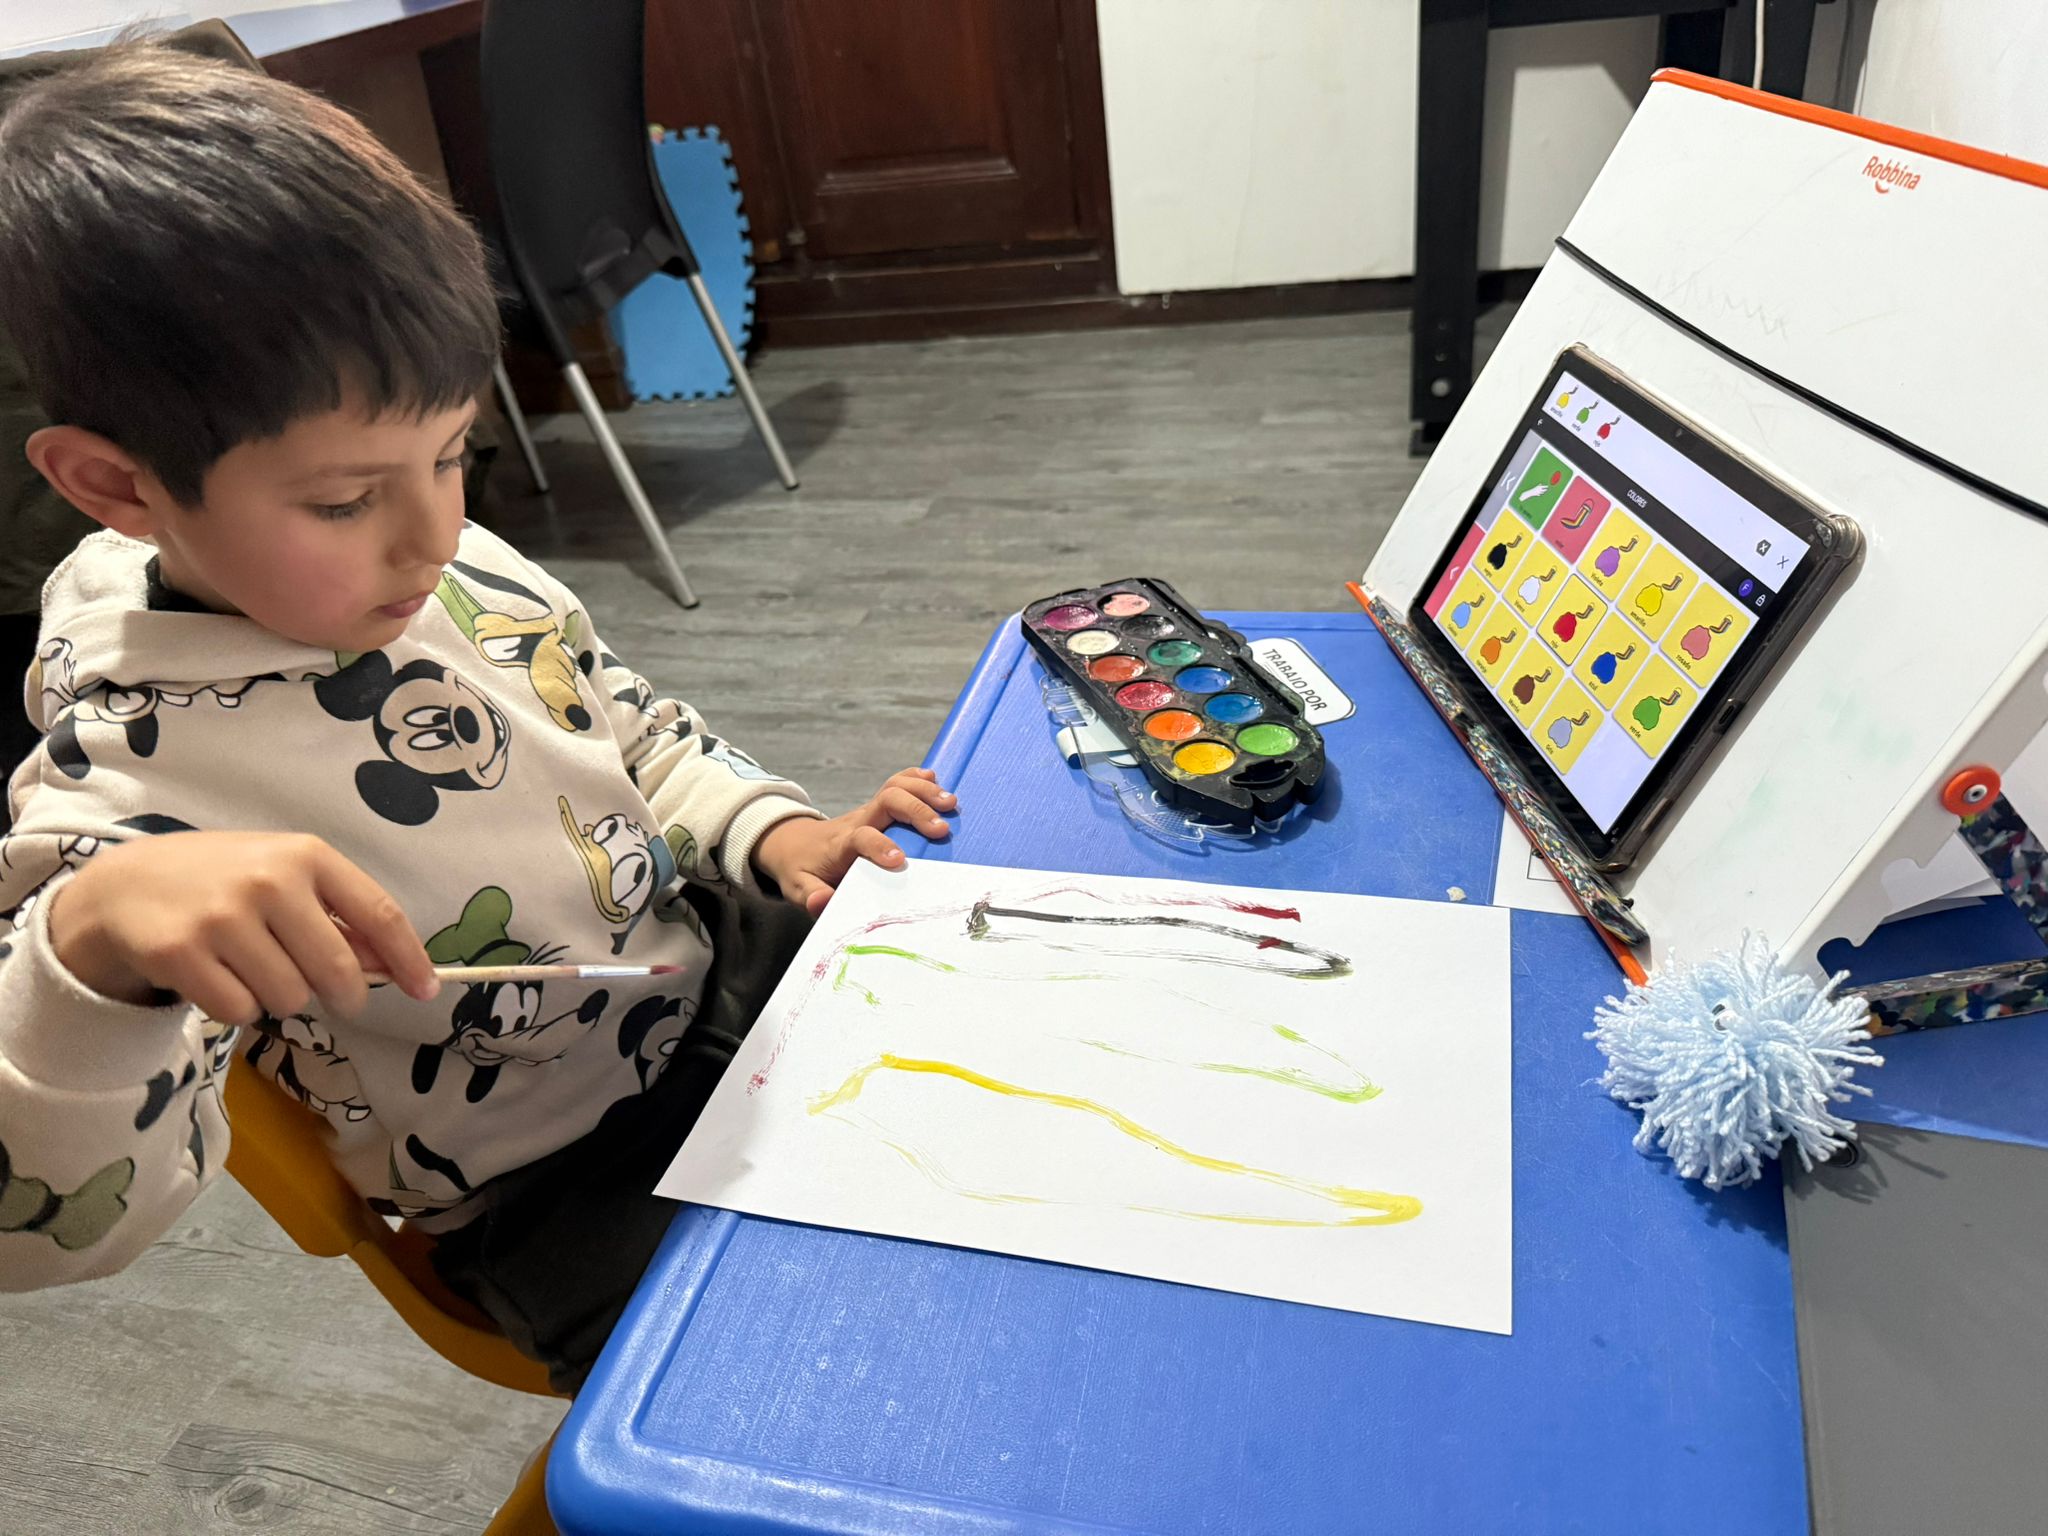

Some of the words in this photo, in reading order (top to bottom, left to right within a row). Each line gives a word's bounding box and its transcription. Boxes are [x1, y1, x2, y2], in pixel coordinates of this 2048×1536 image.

[1862, 155, 1921, 190] Robbina
[1626, 489, 1648, 509] COLORES
[1262, 649, 1307, 691] TRABAJO
[1301, 689, 1328, 711] POR
